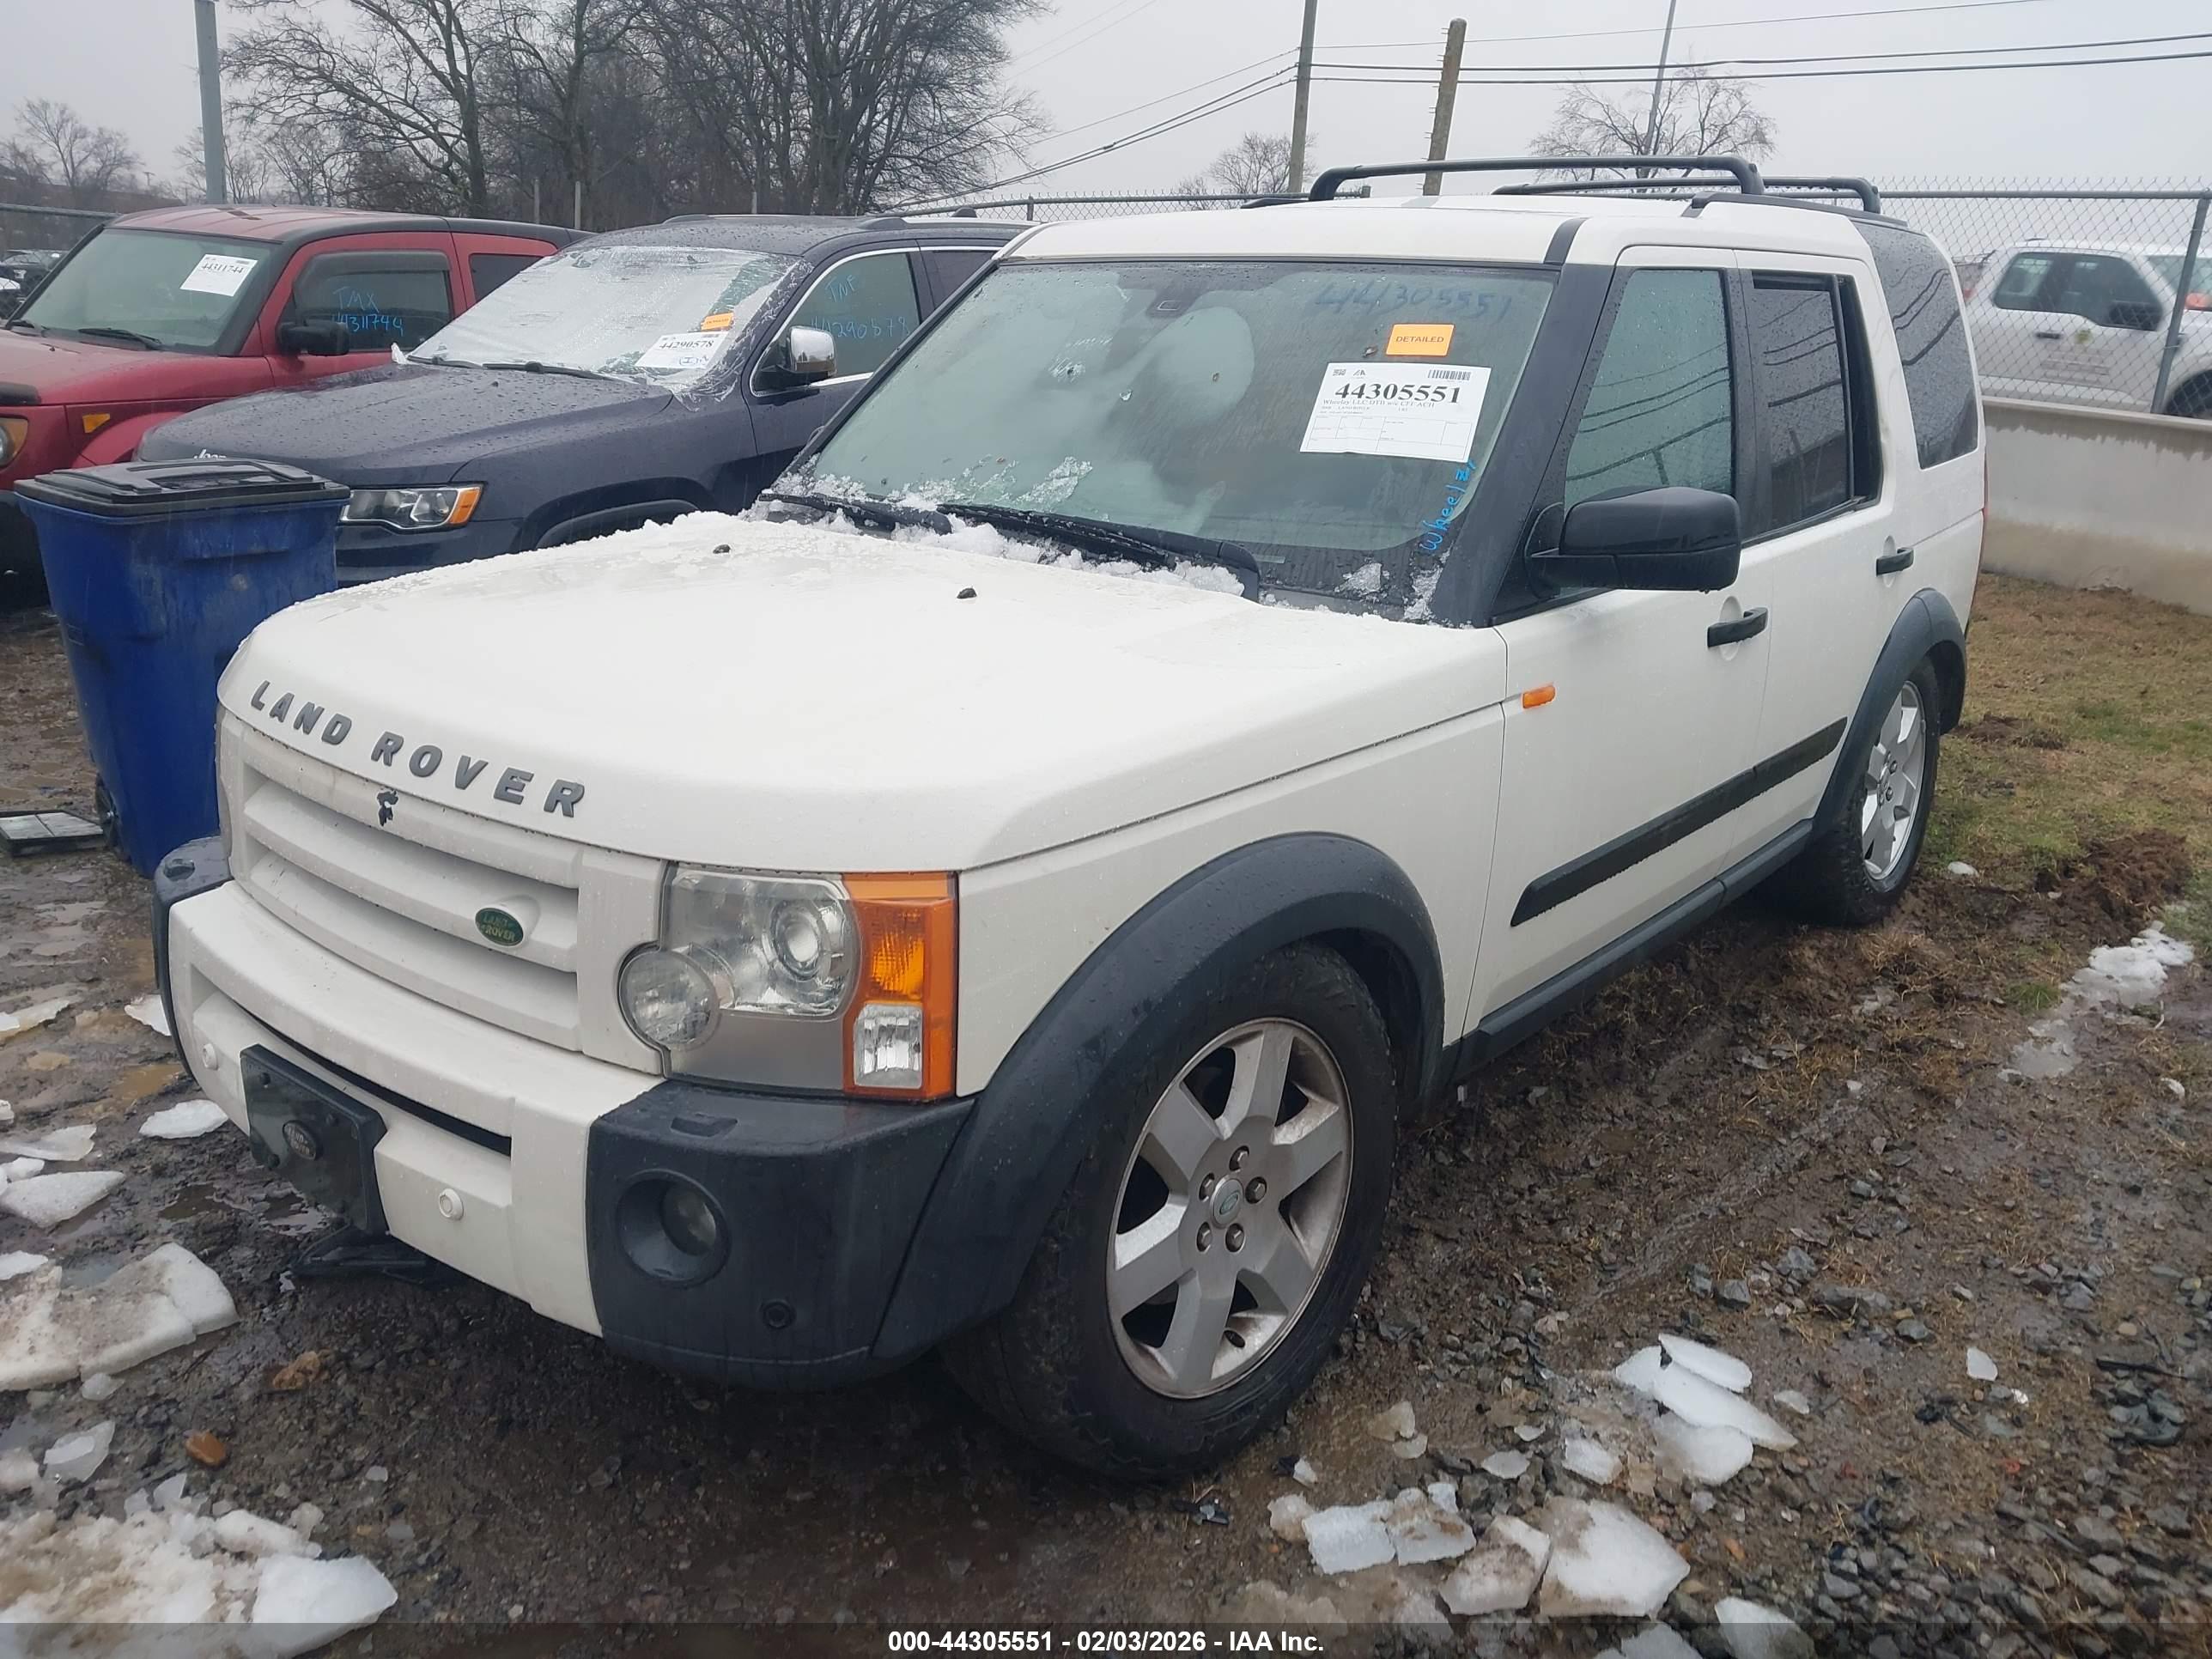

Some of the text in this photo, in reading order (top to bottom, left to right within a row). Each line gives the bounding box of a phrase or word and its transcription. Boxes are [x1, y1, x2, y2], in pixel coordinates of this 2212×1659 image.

[659, 340, 714, 349] 44290578
[1334, 383, 1462, 404] 44305551
[251, 680, 585, 817] LAND ROVER
